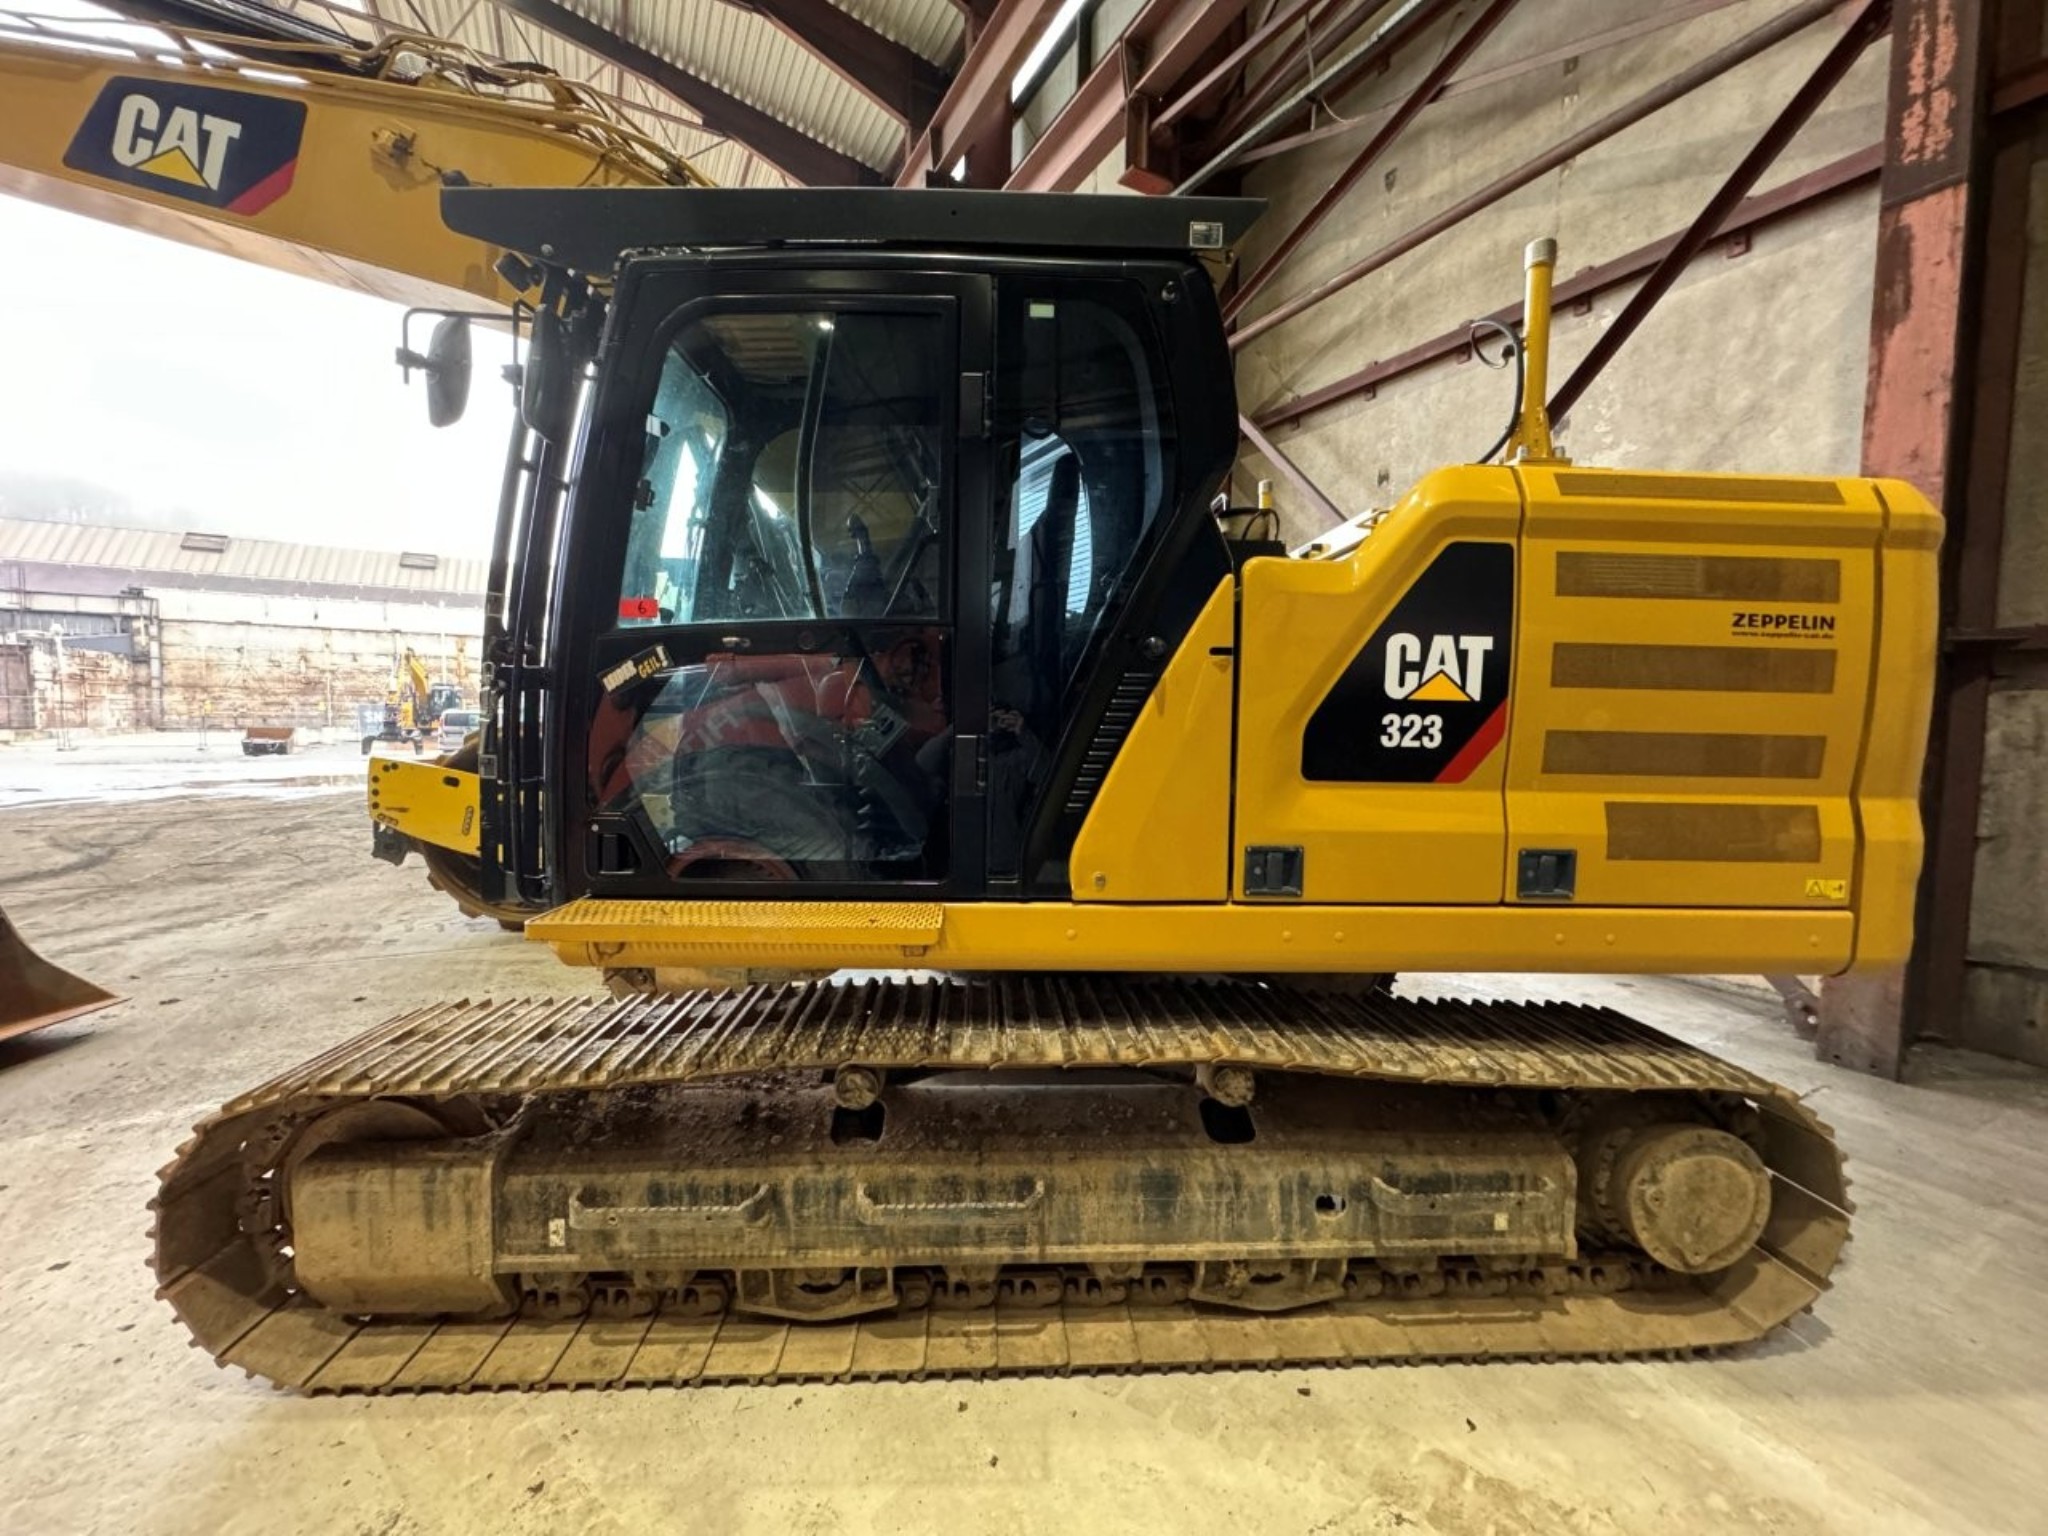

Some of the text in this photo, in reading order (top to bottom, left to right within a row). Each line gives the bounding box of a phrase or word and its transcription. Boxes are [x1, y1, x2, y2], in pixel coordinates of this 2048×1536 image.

[112, 94, 242, 191] CAT
[637, 600, 647, 615] 6
[1732, 613, 1835, 630] ZEPPELIN
[1384, 633, 1493, 702] CAT
[1380, 713, 1443, 749] 323
